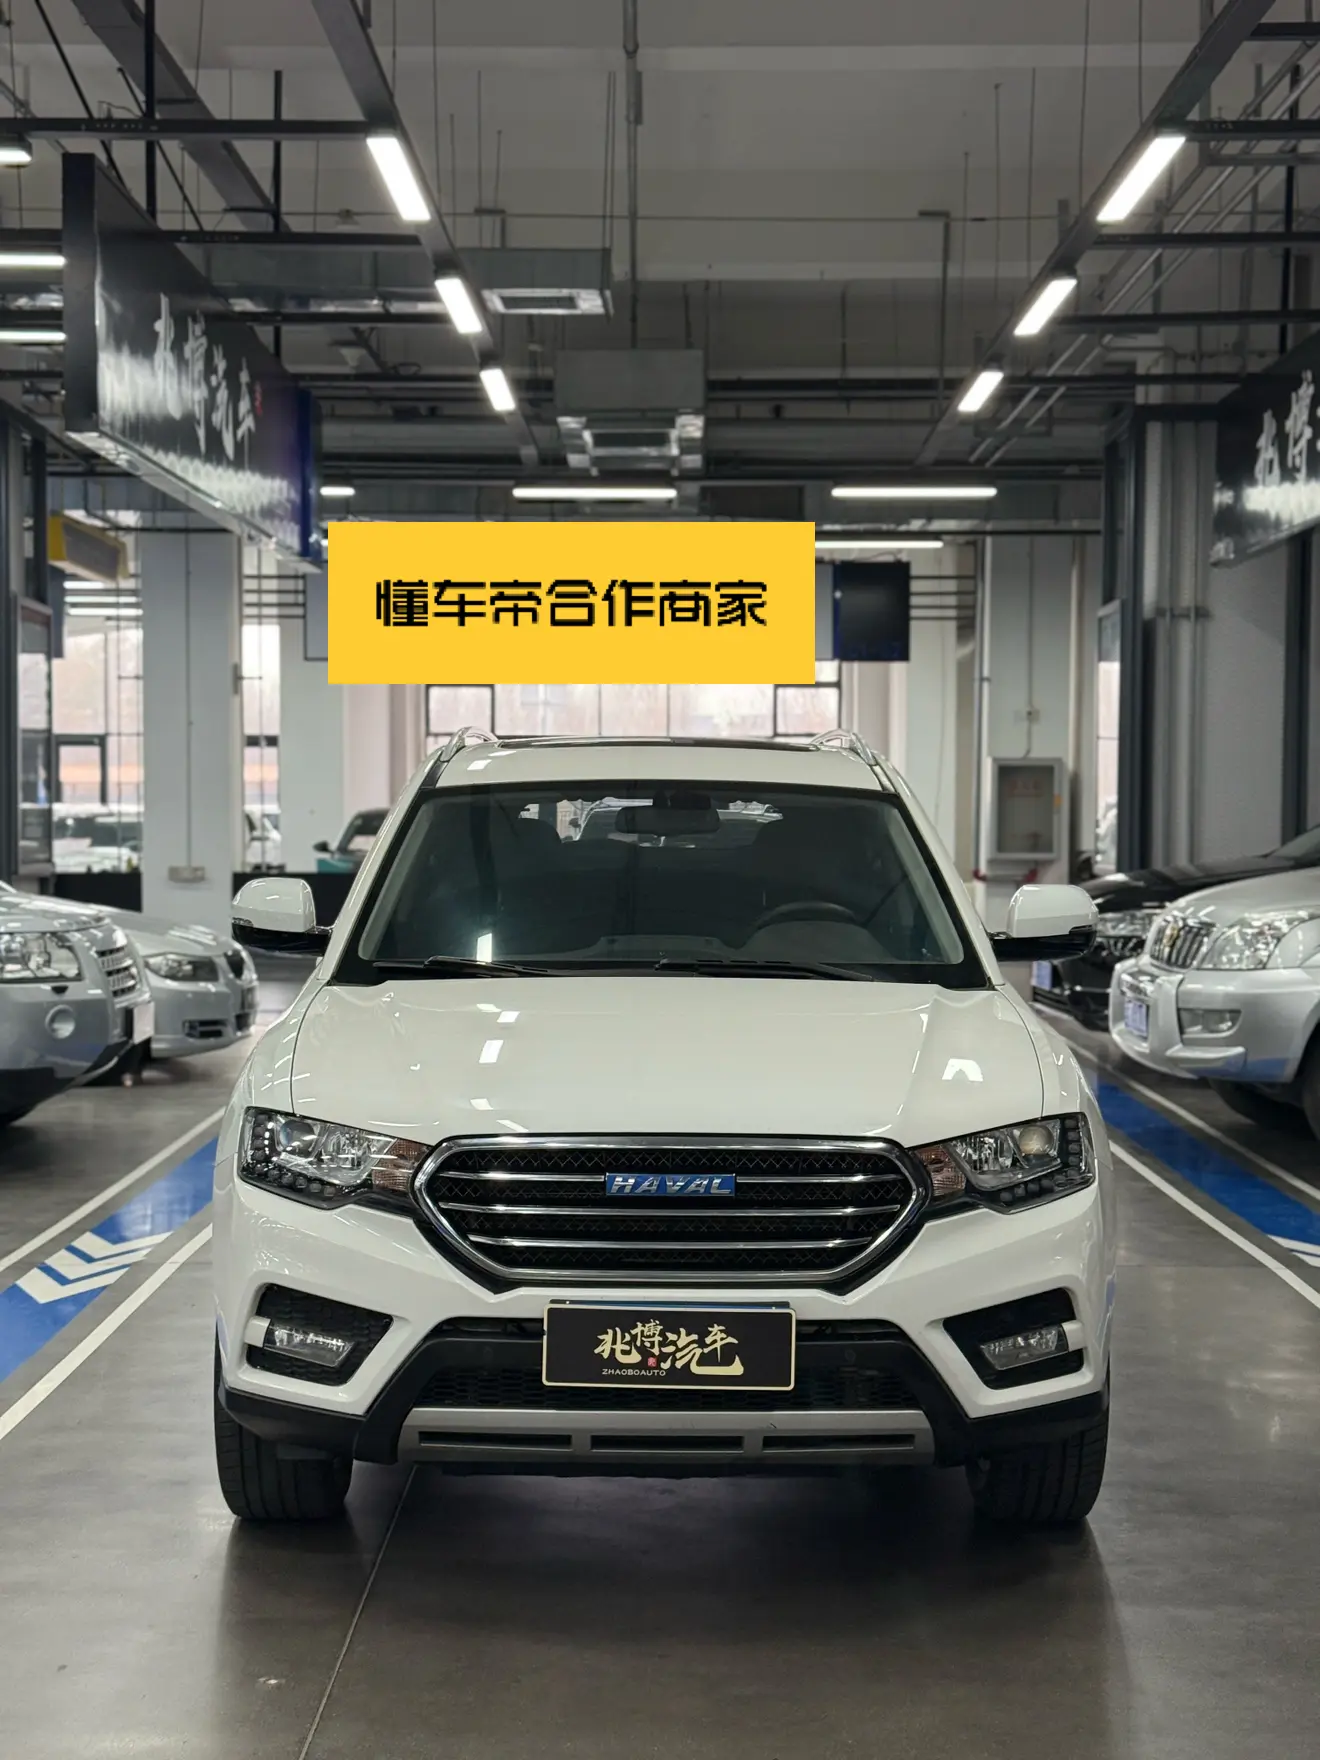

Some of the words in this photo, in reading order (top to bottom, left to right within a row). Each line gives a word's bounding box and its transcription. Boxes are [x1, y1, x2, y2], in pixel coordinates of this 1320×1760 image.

[609, 1175, 732, 1195] HAVAL
[593, 1319, 745, 1376] 兆博汽车
[601, 1368, 667, 1377] ZHAOBOAUTO
